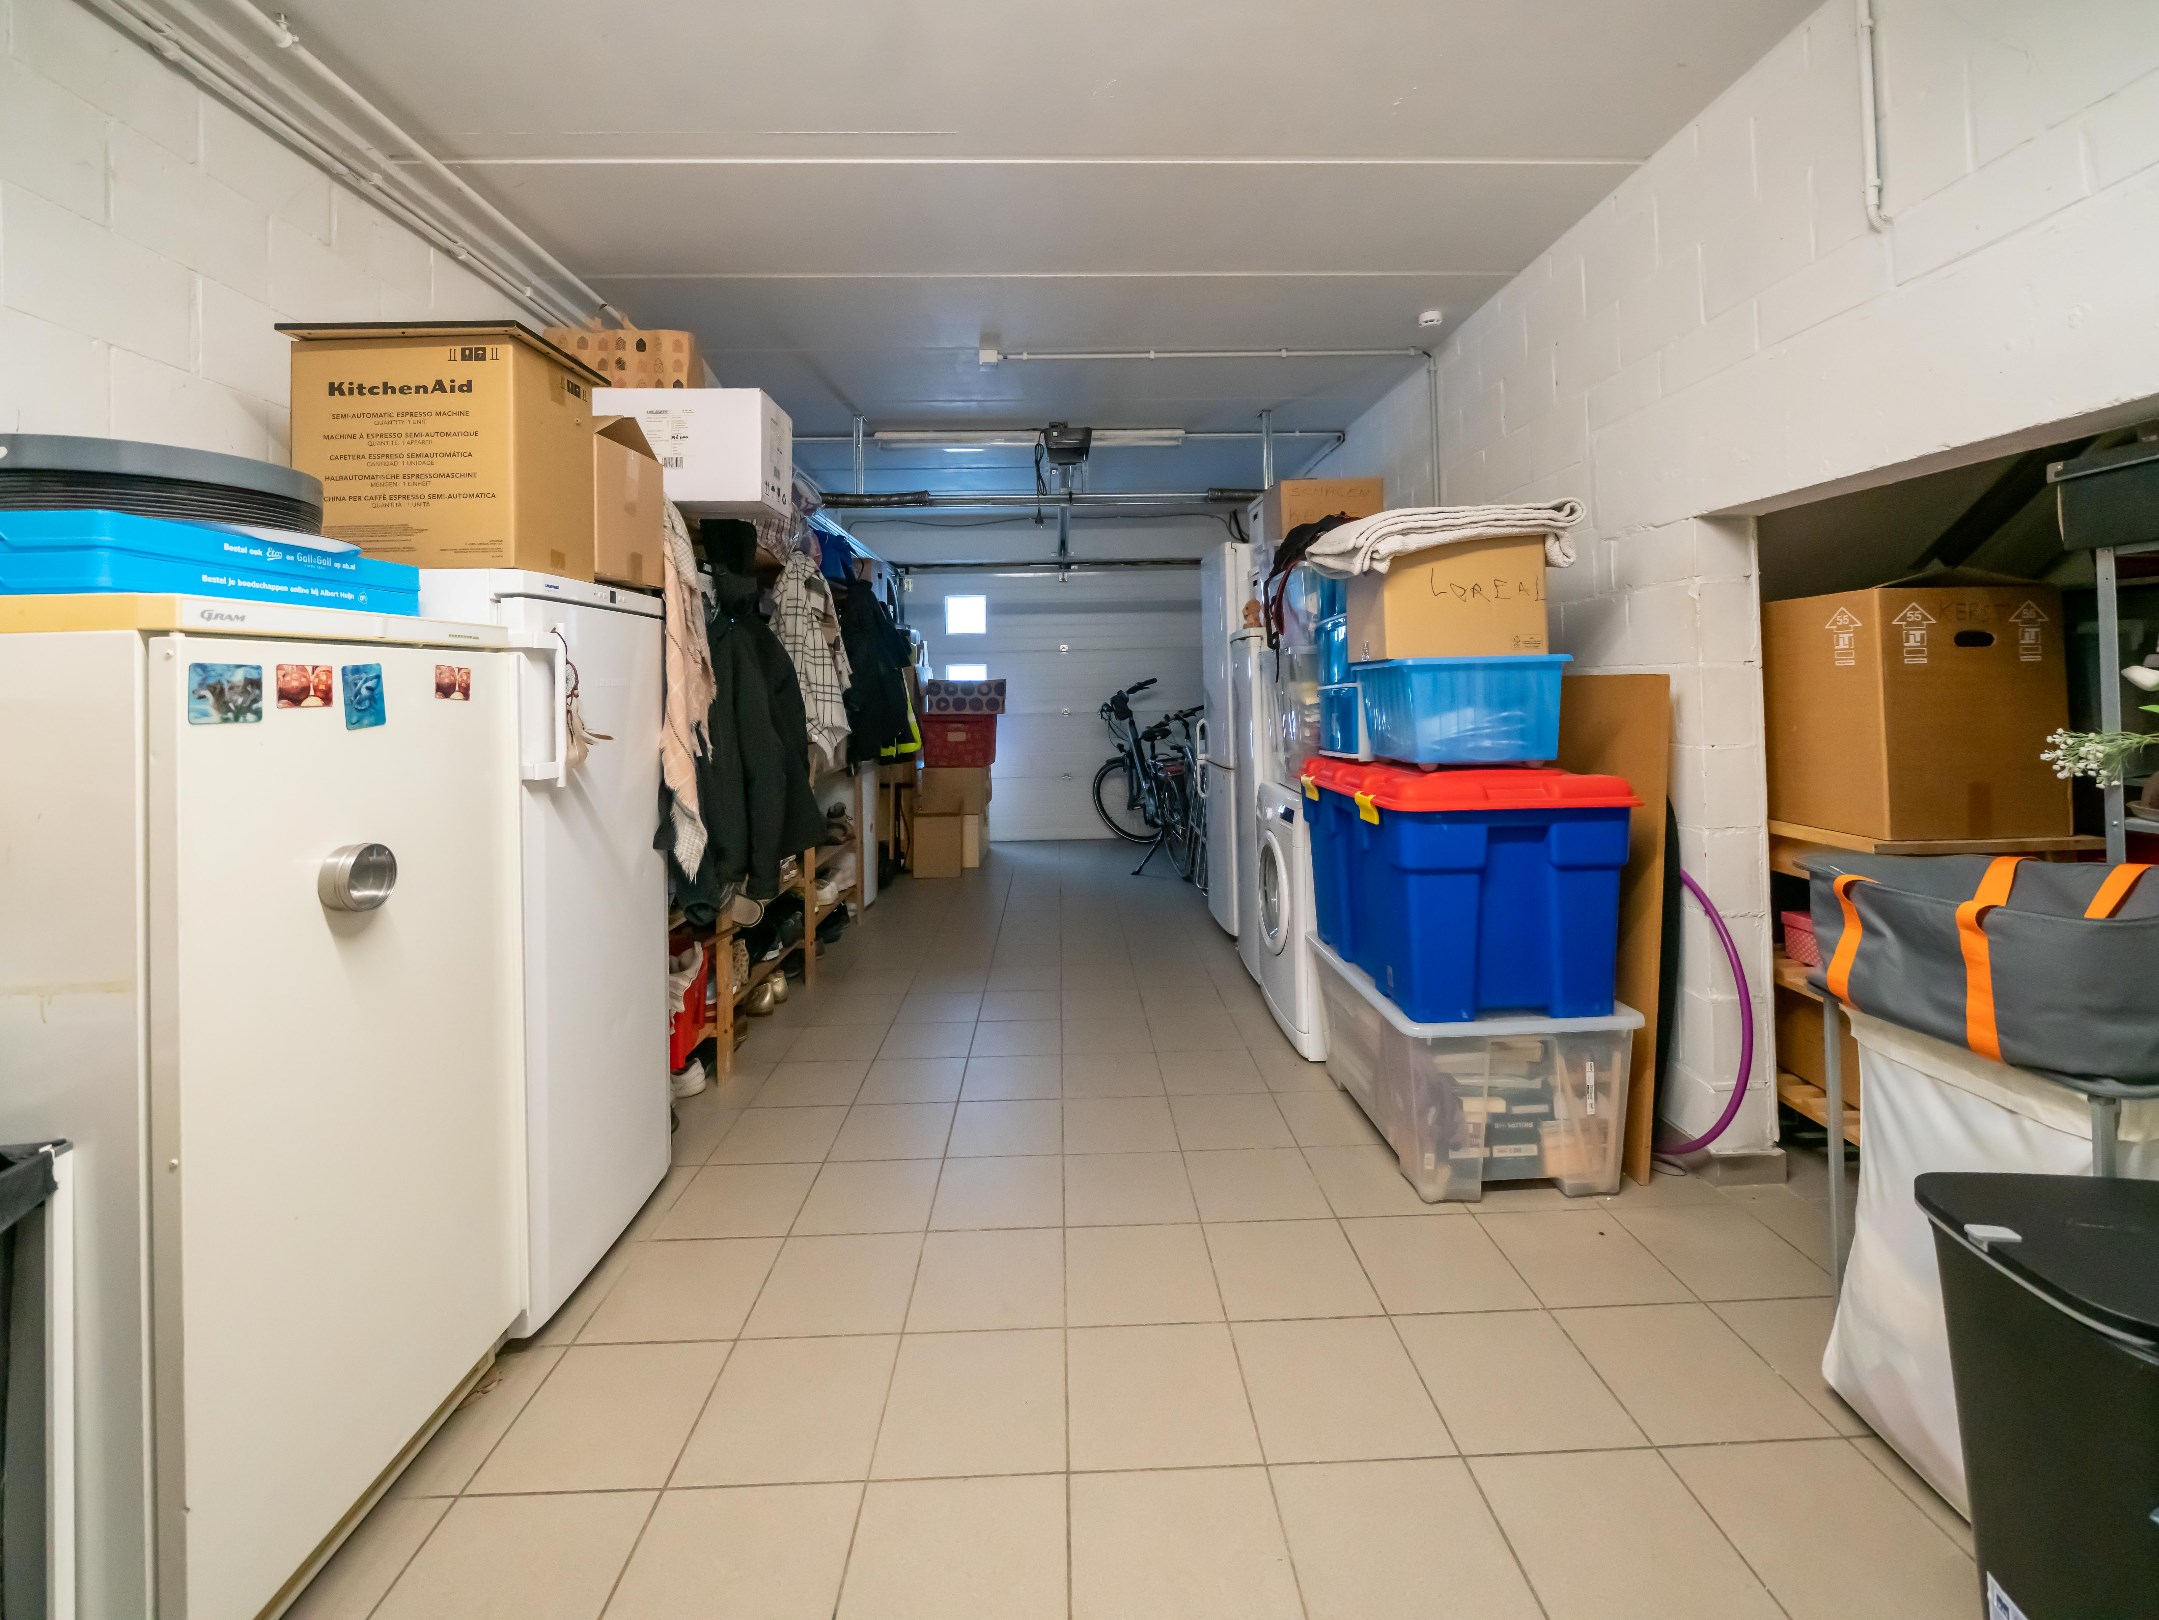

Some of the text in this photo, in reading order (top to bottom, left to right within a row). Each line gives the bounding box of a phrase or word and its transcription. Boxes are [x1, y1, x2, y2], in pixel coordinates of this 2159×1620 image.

[328, 379, 473, 397] KitchenAid
[331, 411, 395, 420] SEMI-AUTOMATIC
[322, 433, 357, 441] MACHINE
[366, 432, 403, 440] ESPRESSO
[405, 430, 480, 439] SEMI-AUTOMATIQUE
[329, 453, 367, 461] CAFETERA
[402, 471, 478, 480] ESPRESSOMASCHINE
[388, 493, 426, 501] ESPRESSO
[223, 542, 248, 554] Bestel
[249, 548, 263, 556] ook
[333, 561, 341, 569] op
[201, 574, 355, 600] Bestel je boodschappen online bij Albert Heijn
[200, 609, 246, 622] GRAM
[1906, 610, 1922, 622] 55
[2021, 608, 2036, 619] 55
[1836, 614, 1850, 626] 55
